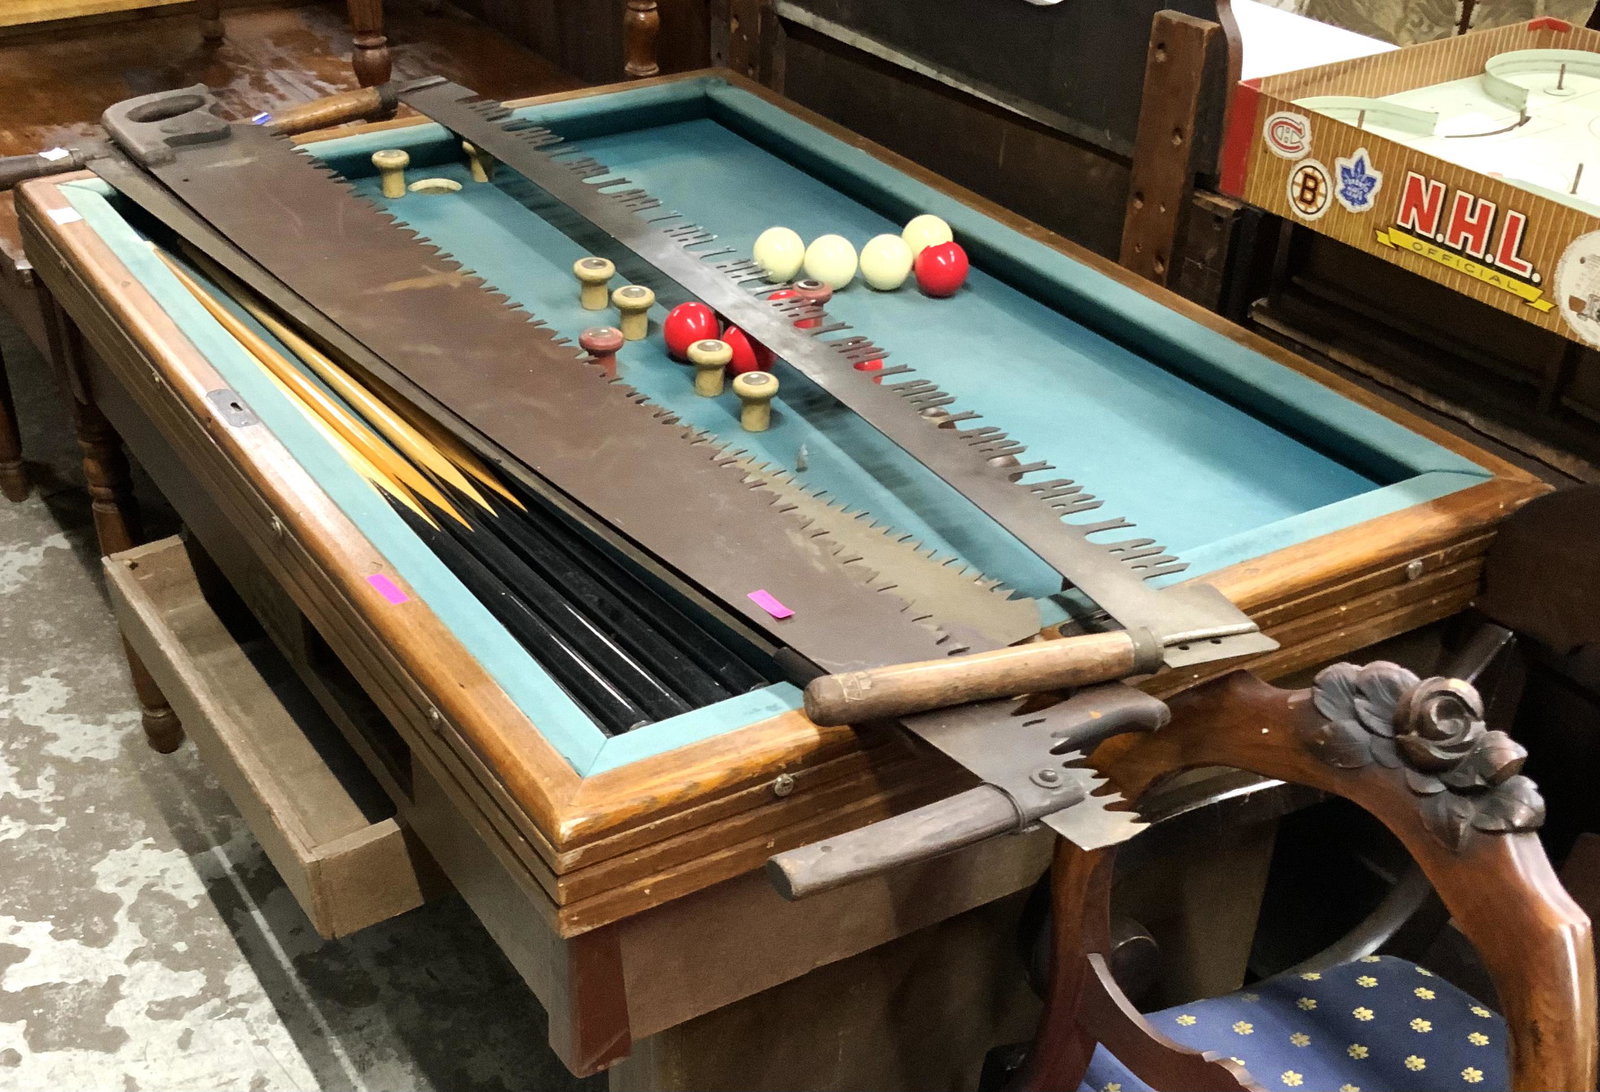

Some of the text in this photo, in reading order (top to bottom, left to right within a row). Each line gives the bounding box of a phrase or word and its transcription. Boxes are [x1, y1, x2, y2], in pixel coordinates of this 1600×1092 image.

[1300, 173, 1318, 205] B
[1397, 171, 1541, 283] N.H.L.
[1412, 241, 1518, 292] OFFICIAL
